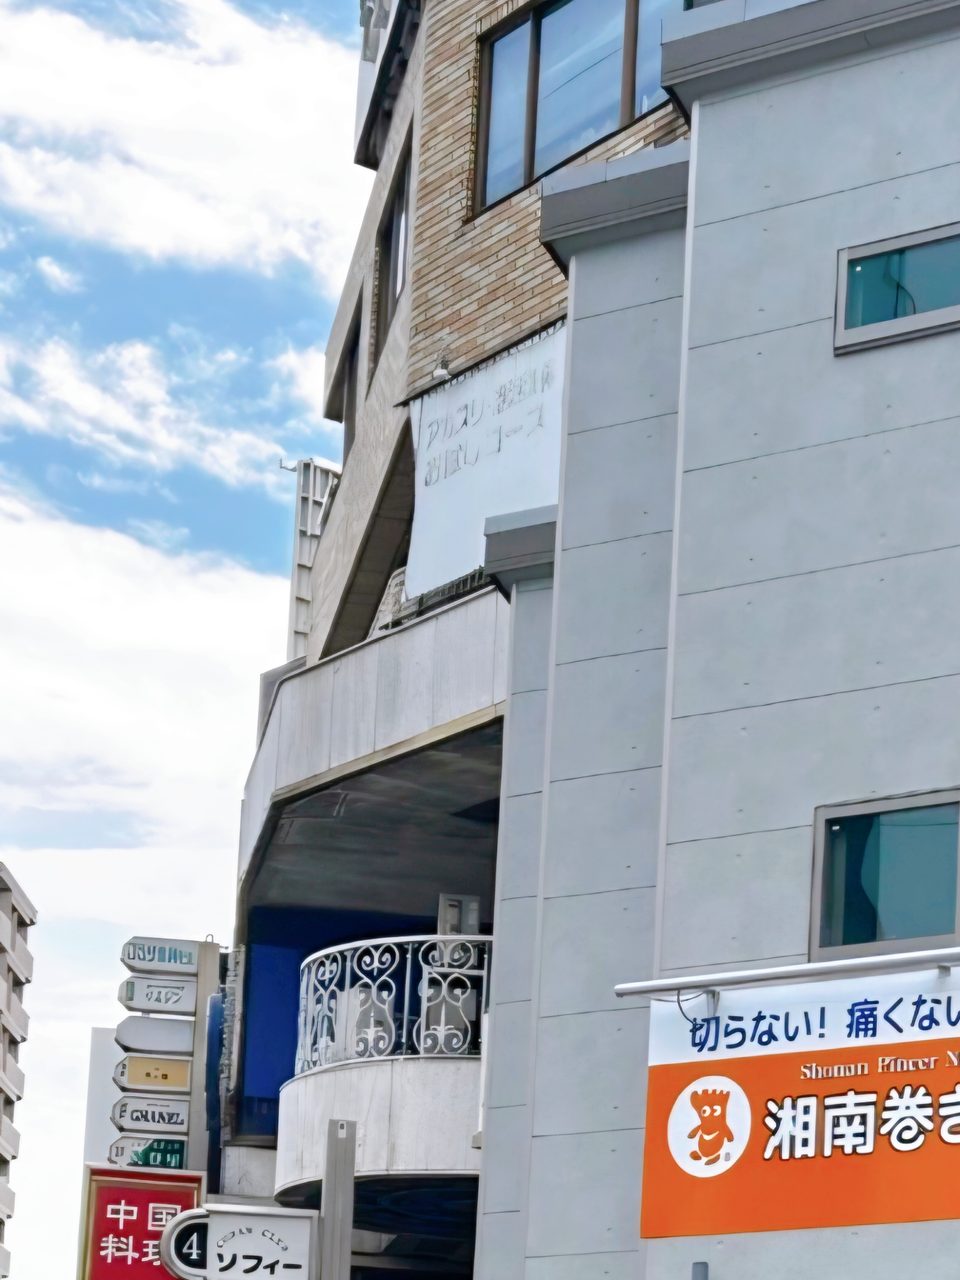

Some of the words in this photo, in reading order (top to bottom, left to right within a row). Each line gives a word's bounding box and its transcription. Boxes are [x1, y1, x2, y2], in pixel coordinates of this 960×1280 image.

[182, 1232, 202, 1259] 4
[216, 1253, 303, 1275] ソフィー
